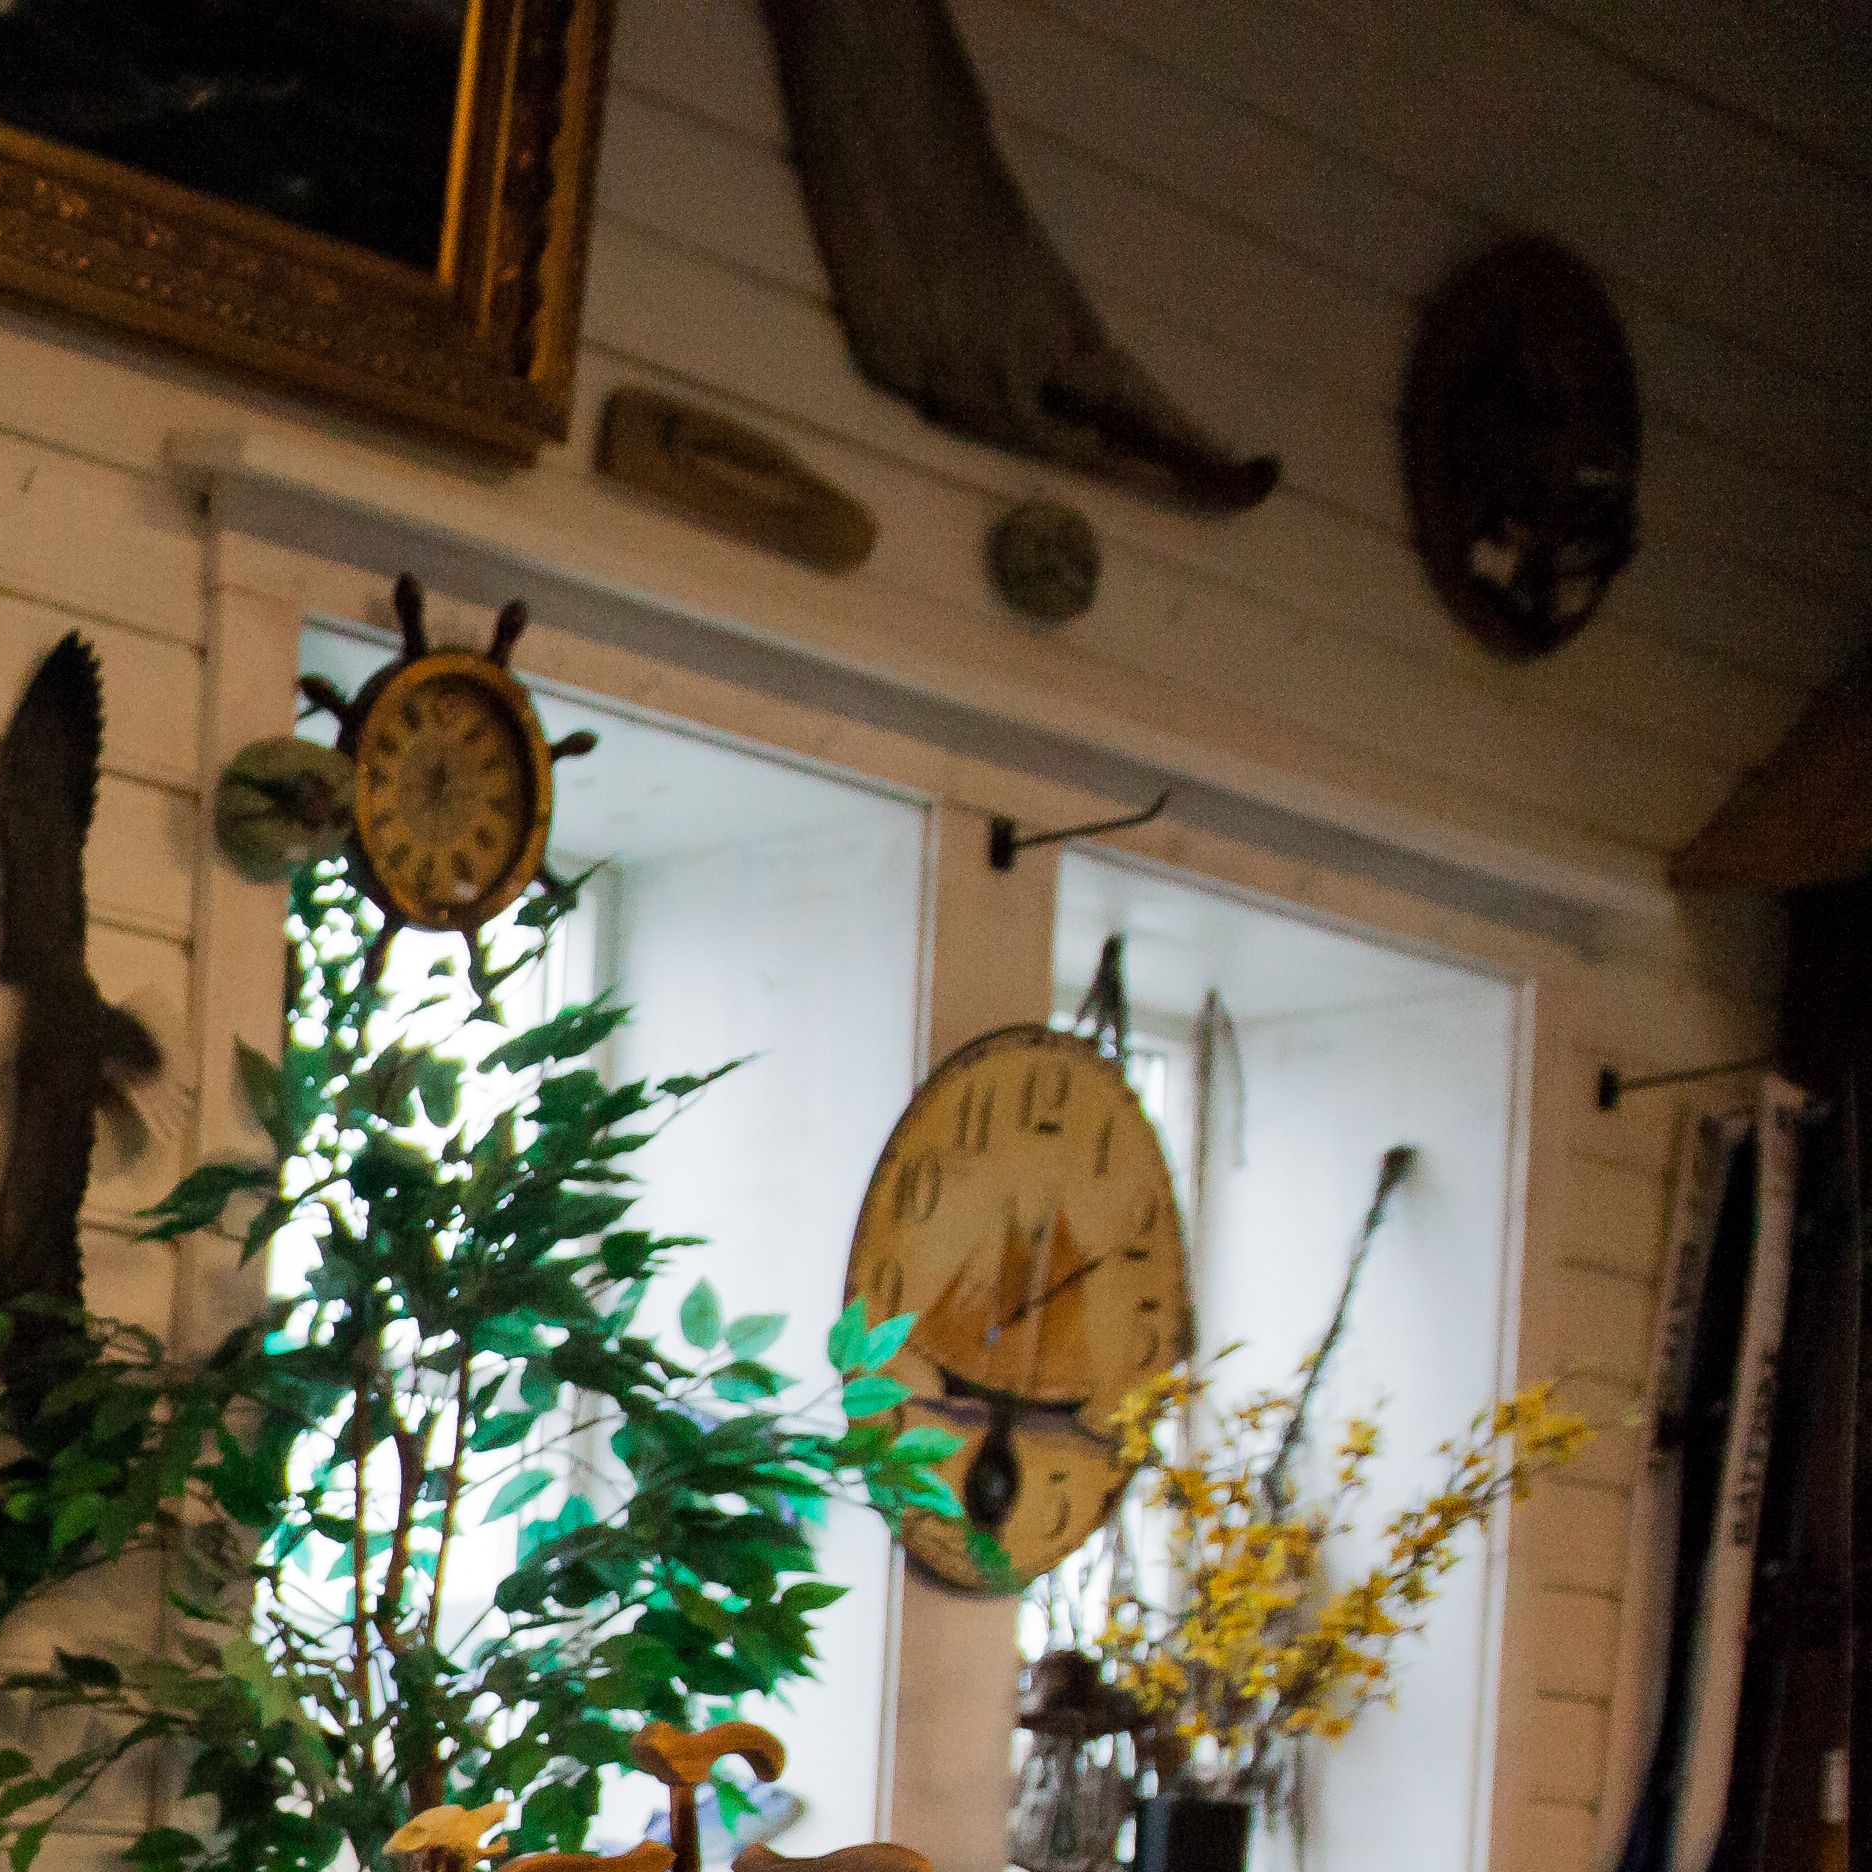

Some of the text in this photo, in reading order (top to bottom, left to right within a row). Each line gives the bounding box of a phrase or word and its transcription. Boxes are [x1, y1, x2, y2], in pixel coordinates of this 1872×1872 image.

[956, 1082, 996, 1153] 11
[1016, 1063, 1073, 1136] 12
[892, 1151, 943, 1224] 10
